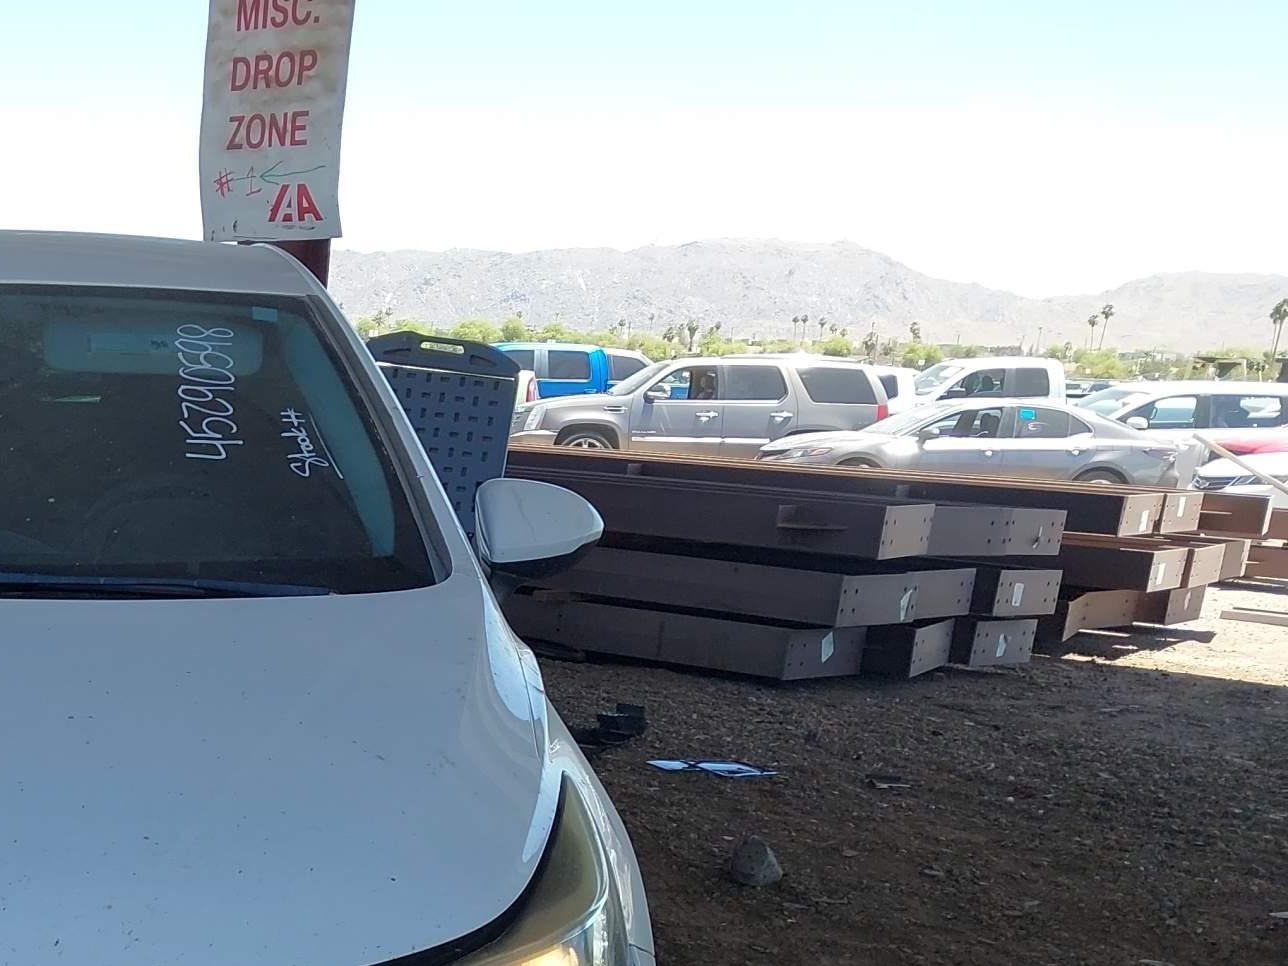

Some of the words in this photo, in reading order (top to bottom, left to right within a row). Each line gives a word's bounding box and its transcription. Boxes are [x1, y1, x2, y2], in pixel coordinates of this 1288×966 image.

[236, 0, 320, 32] MISC.
[230, 49, 318, 92] DROP
[226, 110, 310, 150] ZONE
[175, 324, 244, 460] 45290598
